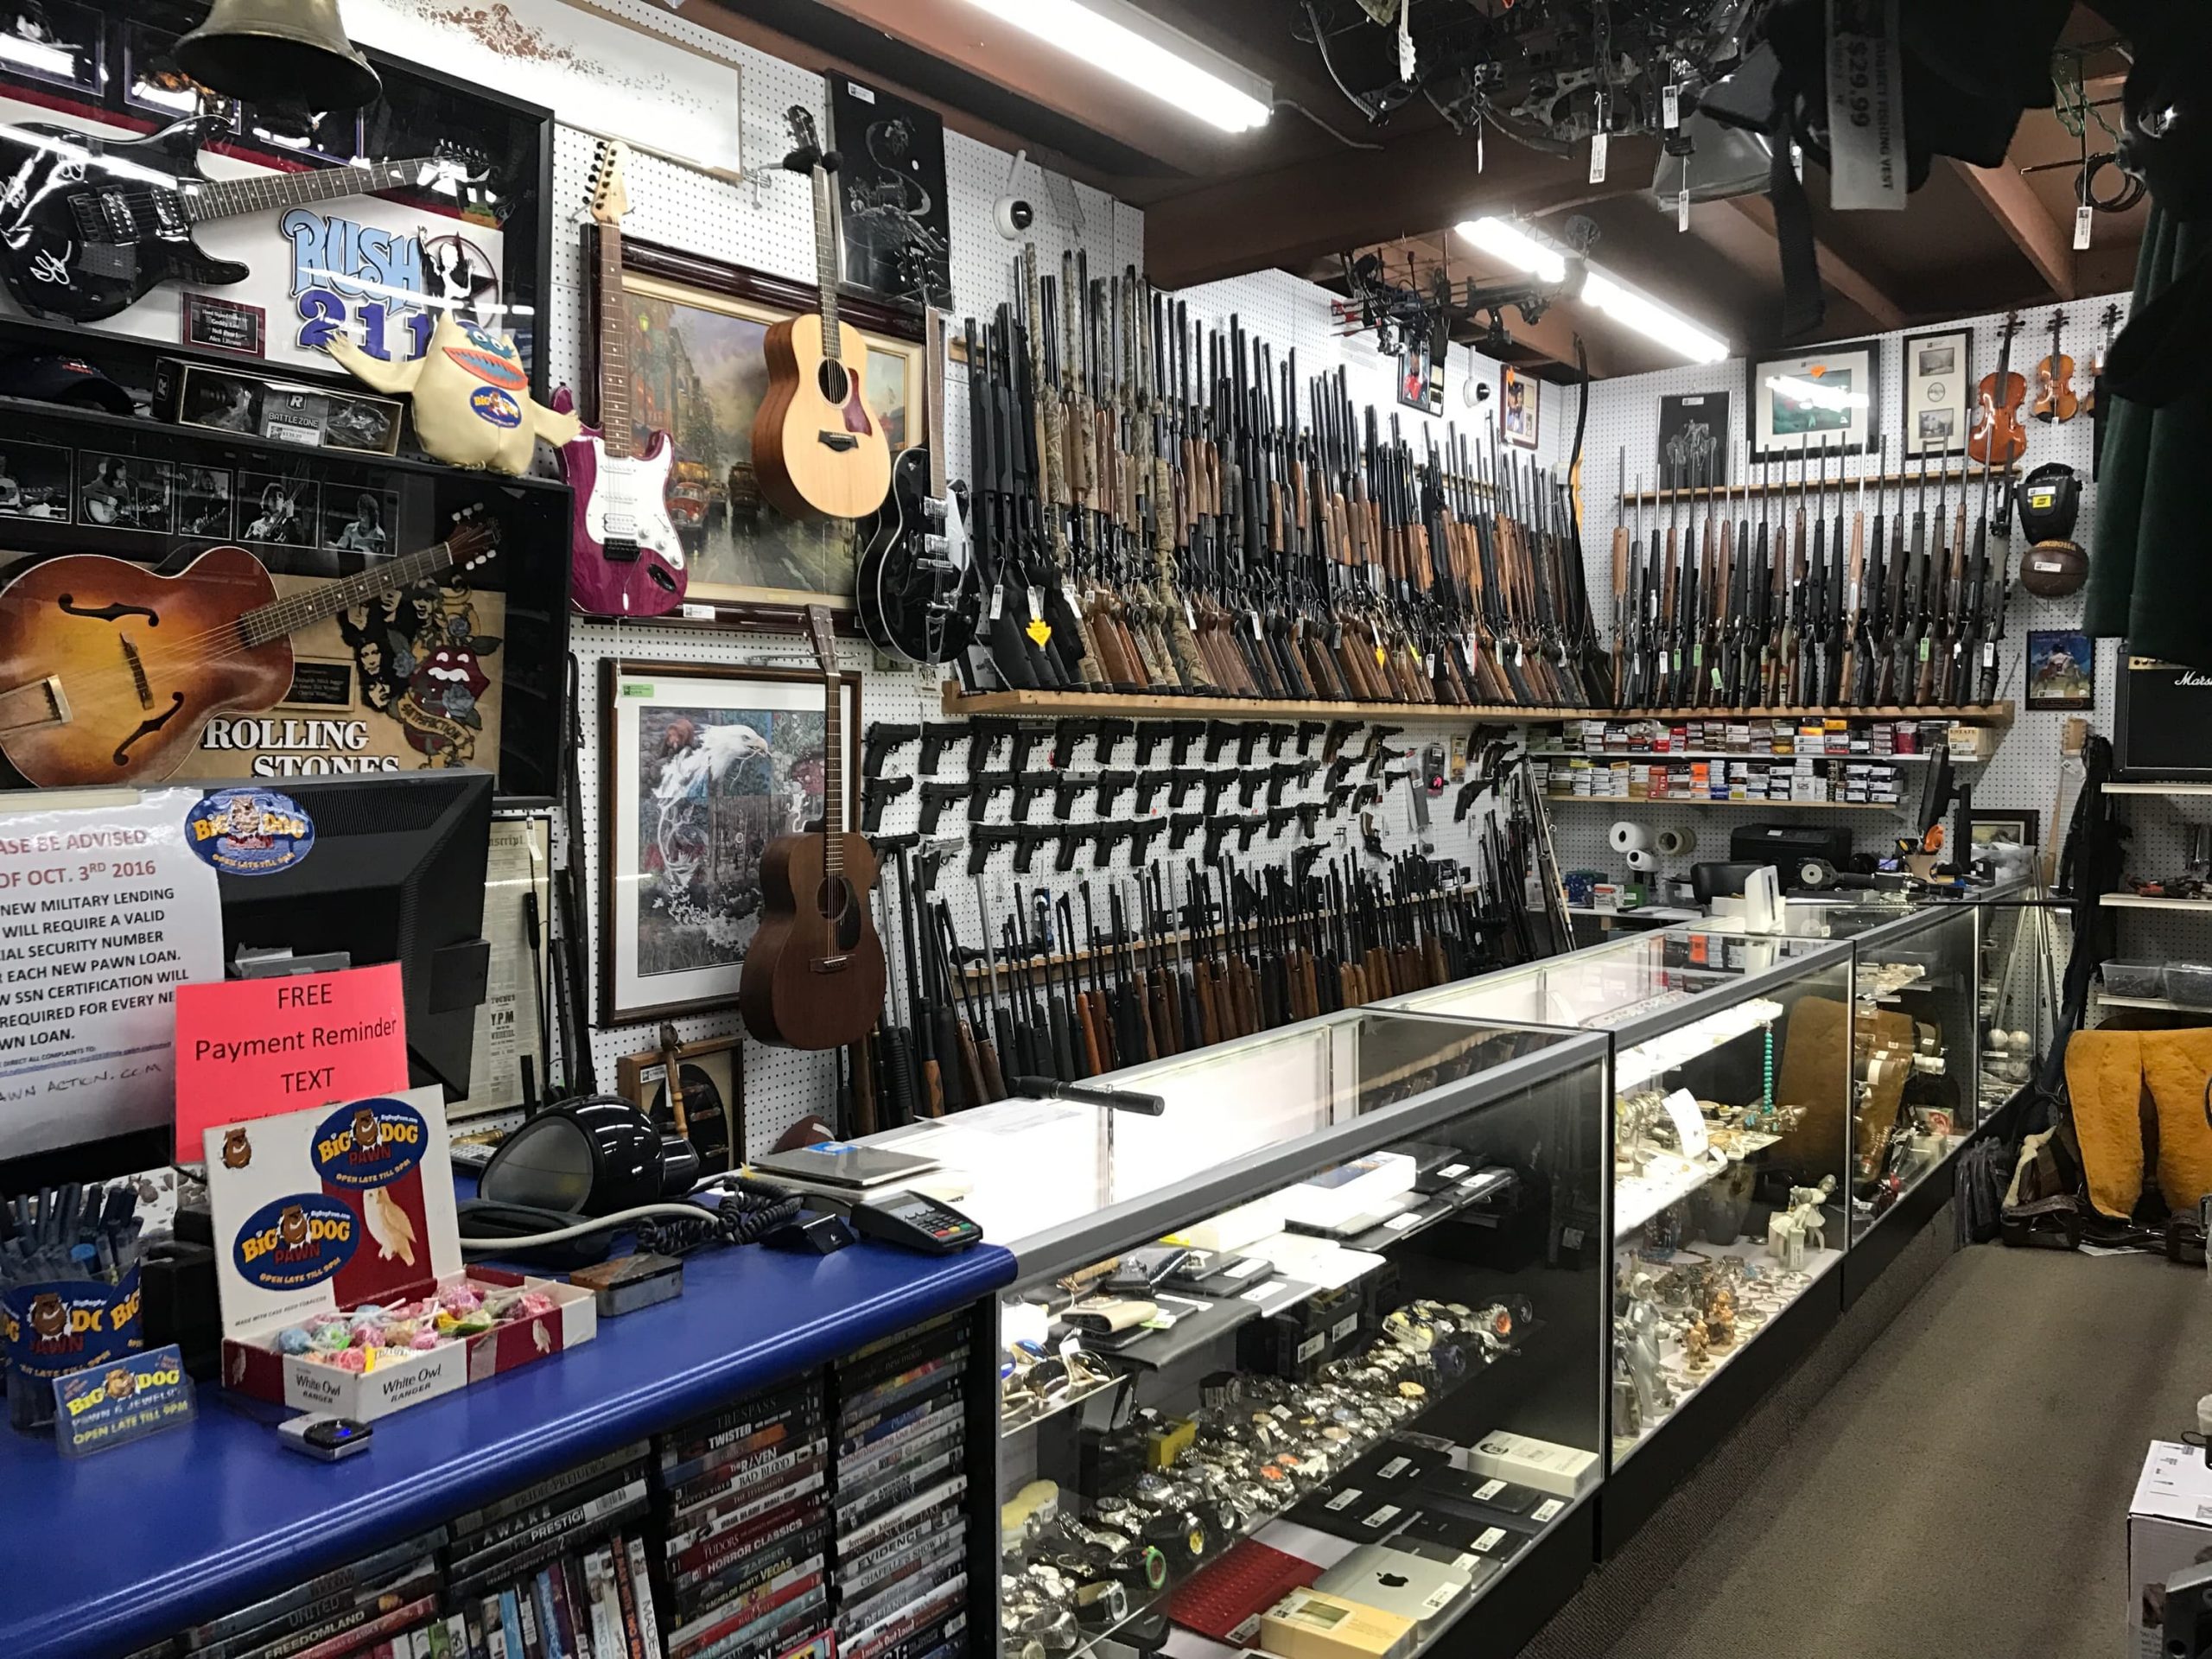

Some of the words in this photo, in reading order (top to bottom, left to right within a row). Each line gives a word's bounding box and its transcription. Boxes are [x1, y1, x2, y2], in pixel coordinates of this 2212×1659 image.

[1849, 41, 1871, 128] $29.99
[1879, 157, 1894, 190] VEST
[281, 208, 423, 316] RUSH
[268, 412, 320, 429] BATTLEZONE
[203, 719, 370, 750] ROLLING
[400, 701, 461, 741] SATISFACTION
[37, 835, 61, 852] BE
[67, 830, 148, 850] ADVISED
[28, 868, 74, 887] OCT.
[112, 860, 157, 879] 2016
[1, 900, 36, 917] NEW
[41, 893, 110, 913] MILITARY
[113, 887, 175, 906] LENDING
[3, 923, 40, 939] WILL
[43, 915, 106, 935] REQUIRE
[110, 914, 121, 927] A
[124, 909, 165, 925] VALID
[0, 947, 25, 962] IAL
[28, 938, 98, 958] SECURITY
[102, 930, 164, 949] NUMBER
[8, 966, 48, 983] EACH
[52, 961, 87, 977] NEW
[91, 955, 136, 972] PAWN
[139, 949, 181, 965] LOAN.
[16, 988, 43, 1005] SSN
[48, 973, 154, 1000] CERTIFICATION
[156, 968, 189, 983] WILL
[277, 982, 333, 1009] FREE
[0, 1005, 75, 1029] REQUIRED
[79, 1001, 108, 1017] FOR
[111, 991, 155, 1011] EVERY
[158, 991, 176, 1004] NE
[30, 1028, 75, 1046] LOAN.
[195, 1030, 305, 1064] Payment
[312, 1016, 397, 1048] Reminder
[281, 1067, 335, 1094] TEXT
[380, 1122, 419, 1144] DOG
[348, 1146, 392, 1166] PAWN
[335, 1173, 358, 1184] OPEN
[359, 1175, 378, 1184] LATE
[378, 1169, 395, 1180] TILL
[309, 1218, 351, 1243] DOG
[274, 1243, 321, 1266] PAWN
[259, 1272, 283, 1283] OPEN
[284, 1274, 305, 1285] LATE
[306, 1268, 323, 1281] TILL
[252, 1313, 268, 1323] WITH
[137, 1369, 181, 1389] DOG
[296, 1373, 322, 1392] White
[321, 1380, 341, 1398] Owl
[383, 1375, 416, 1396] White
[417, 1363, 442, 1382] Owl
[390, 1382, 432, 1403] RANGER
[302, 1391, 334, 1404] RANGER
[73, 1427, 108, 1446] OPEN
[111, 1414, 138, 1433] LATE
[139, 1410, 161, 1425] TILL
[162, 1400, 189, 1416] 9PM
[739, 1472, 759, 1488] BAD
[760, 1456, 790, 1479] BLOOD
[741, 1446, 778, 1474] RAVEN
[702, 1535, 741, 1561] TUDORS
[707, 1542, 752, 1575] HORROR
[753, 1517, 804, 1551] CLASSICS
[857, 1525, 923, 1571] EVIDENCE
[912, 1541, 936, 1558] SHOW
[705, 1587, 738, 1611] BACHELOR
[739, 1576, 760, 1592] PARTY
[760, 1555, 793, 1584] VEGAS
[288, 1596, 341, 1629] UNITED
[641, 1599, 659, 1652] MADE
[264, 1609, 365, 1659] FREEDOMLAND
[884, 1631, 898, 1646] Out
